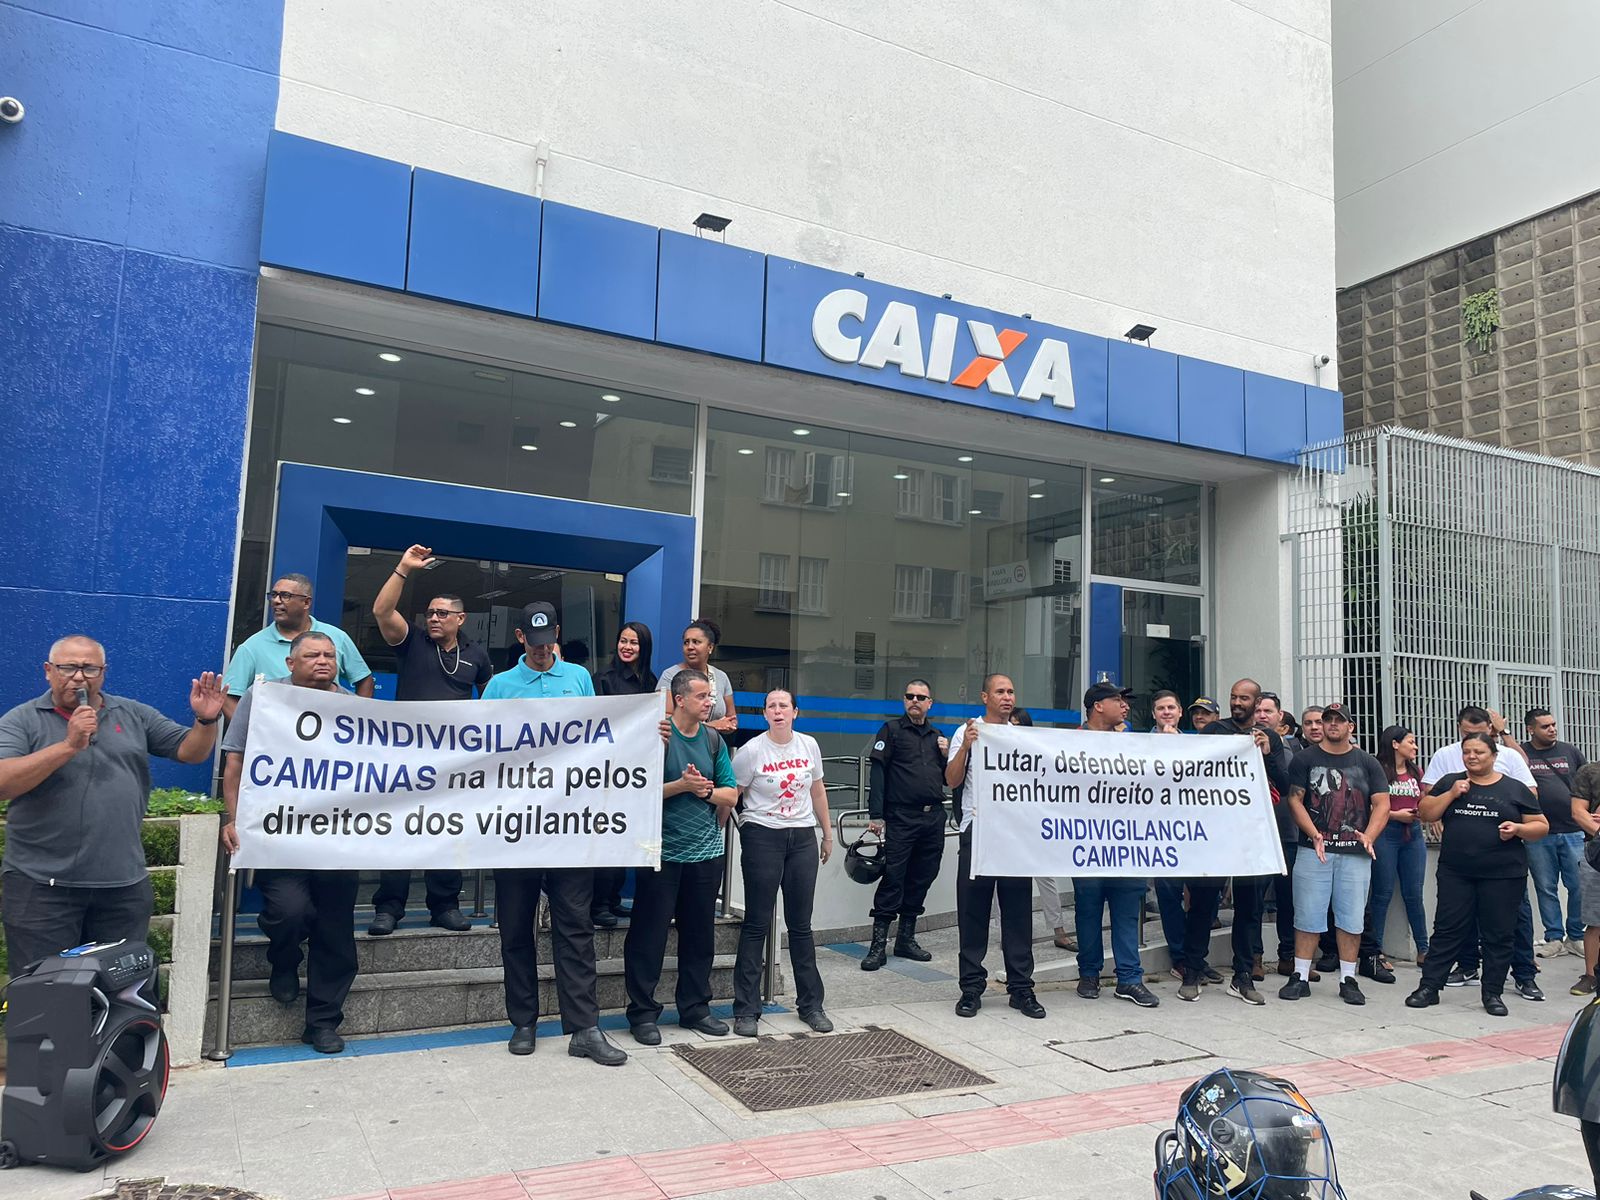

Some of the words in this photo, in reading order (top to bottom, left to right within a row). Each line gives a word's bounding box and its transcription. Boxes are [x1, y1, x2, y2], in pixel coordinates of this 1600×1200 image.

[812, 289, 1075, 409] CAIXA
[295, 711, 322, 741] O
[333, 715, 614, 753] SINDIVIGILANCIA
[250, 754, 436, 793] CAMPINAS
[448, 772, 485, 790] na
[497, 760, 554, 790] luta
[565, 760, 647, 796] pelos
[762, 758, 809, 773] MICKEY
[983, 746, 1046, 778] Lutar,
[1055, 750, 1146, 776] defender
[1154, 760, 1165, 777] e
[1172, 756, 1255, 783] garantir,
[992, 778, 1080, 803] nenhum
[1088, 780, 1154, 805] direito
[1160, 788, 1171, 806] a
[1178, 788, 1251, 806] menos
[263, 805, 392, 836] direitos
[405, 805, 463, 836] dos
[477, 805, 627, 843] vigilantes
[1454, 808, 1482, 816] NOBODY
[1041, 817, 1208, 842] SINDIVIGILANCIA
[1072, 845, 1179, 868] CAMPINAS
[1335, 840, 1357, 848] HEIST
